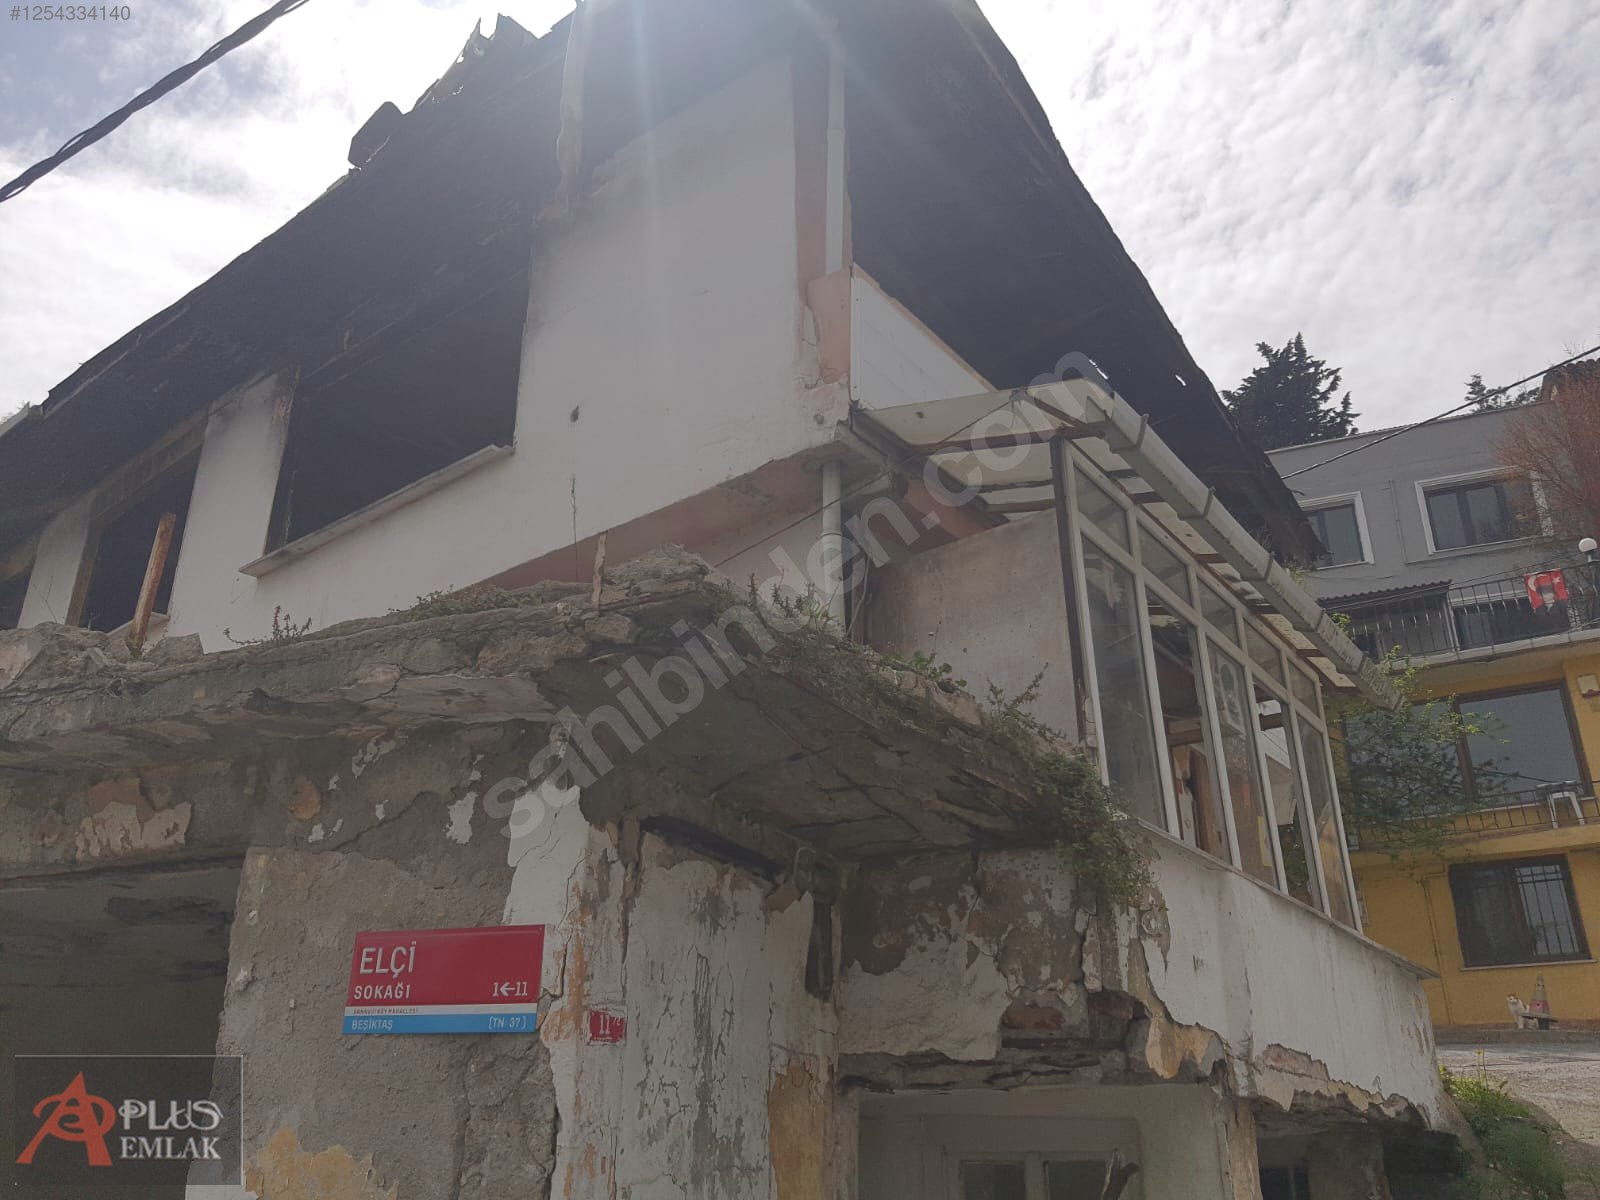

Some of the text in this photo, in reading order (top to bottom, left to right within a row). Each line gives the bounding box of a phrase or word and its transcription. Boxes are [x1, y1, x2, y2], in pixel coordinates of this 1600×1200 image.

[359, 940, 417, 980] ELÇİ
[353, 981, 411, 1000] SOKAĞI
[351, 1018, 393, 1031] BEŞİKTAŞ
